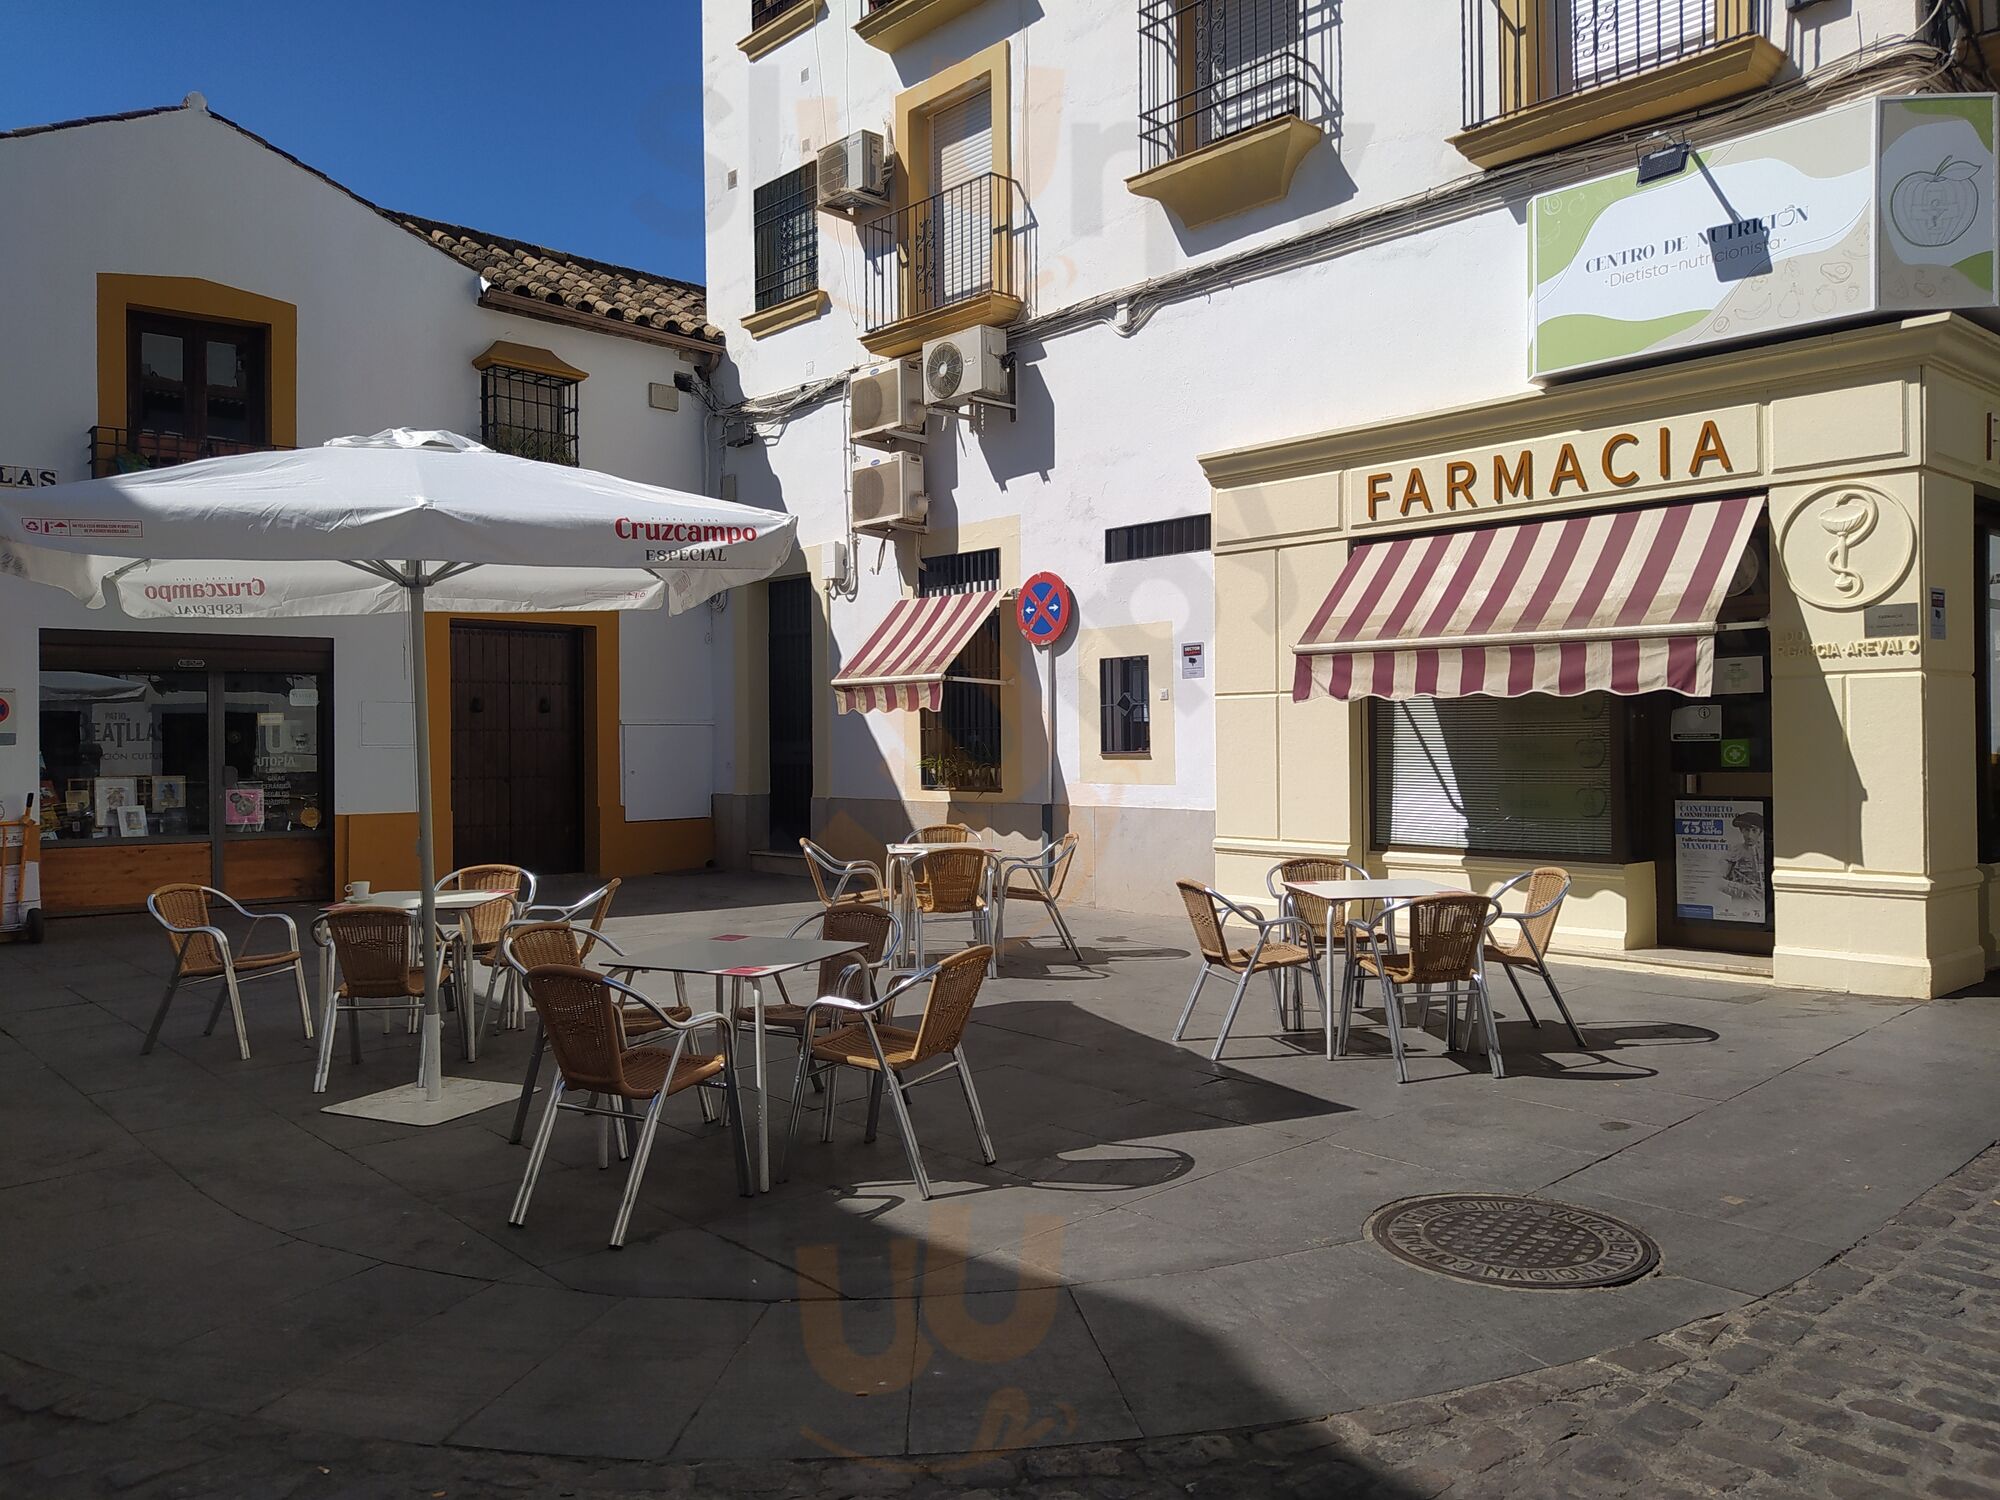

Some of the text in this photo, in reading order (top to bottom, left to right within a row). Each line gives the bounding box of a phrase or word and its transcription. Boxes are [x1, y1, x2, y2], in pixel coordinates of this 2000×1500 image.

[1585, 204, 1810, 274] CENTRO DE NUTRICIÓN
[1366, 420, 1734, 521] FARMACIA
[615, 517, 757, 545] Cruzcampo
[645, 549, 727, 562] ESPECIAL
[1679, 805, 1733, 813] CONCIERTO
[1682, 820, 1701, 834] 75
[1681, 843, 1730, 851] MANOLETE
